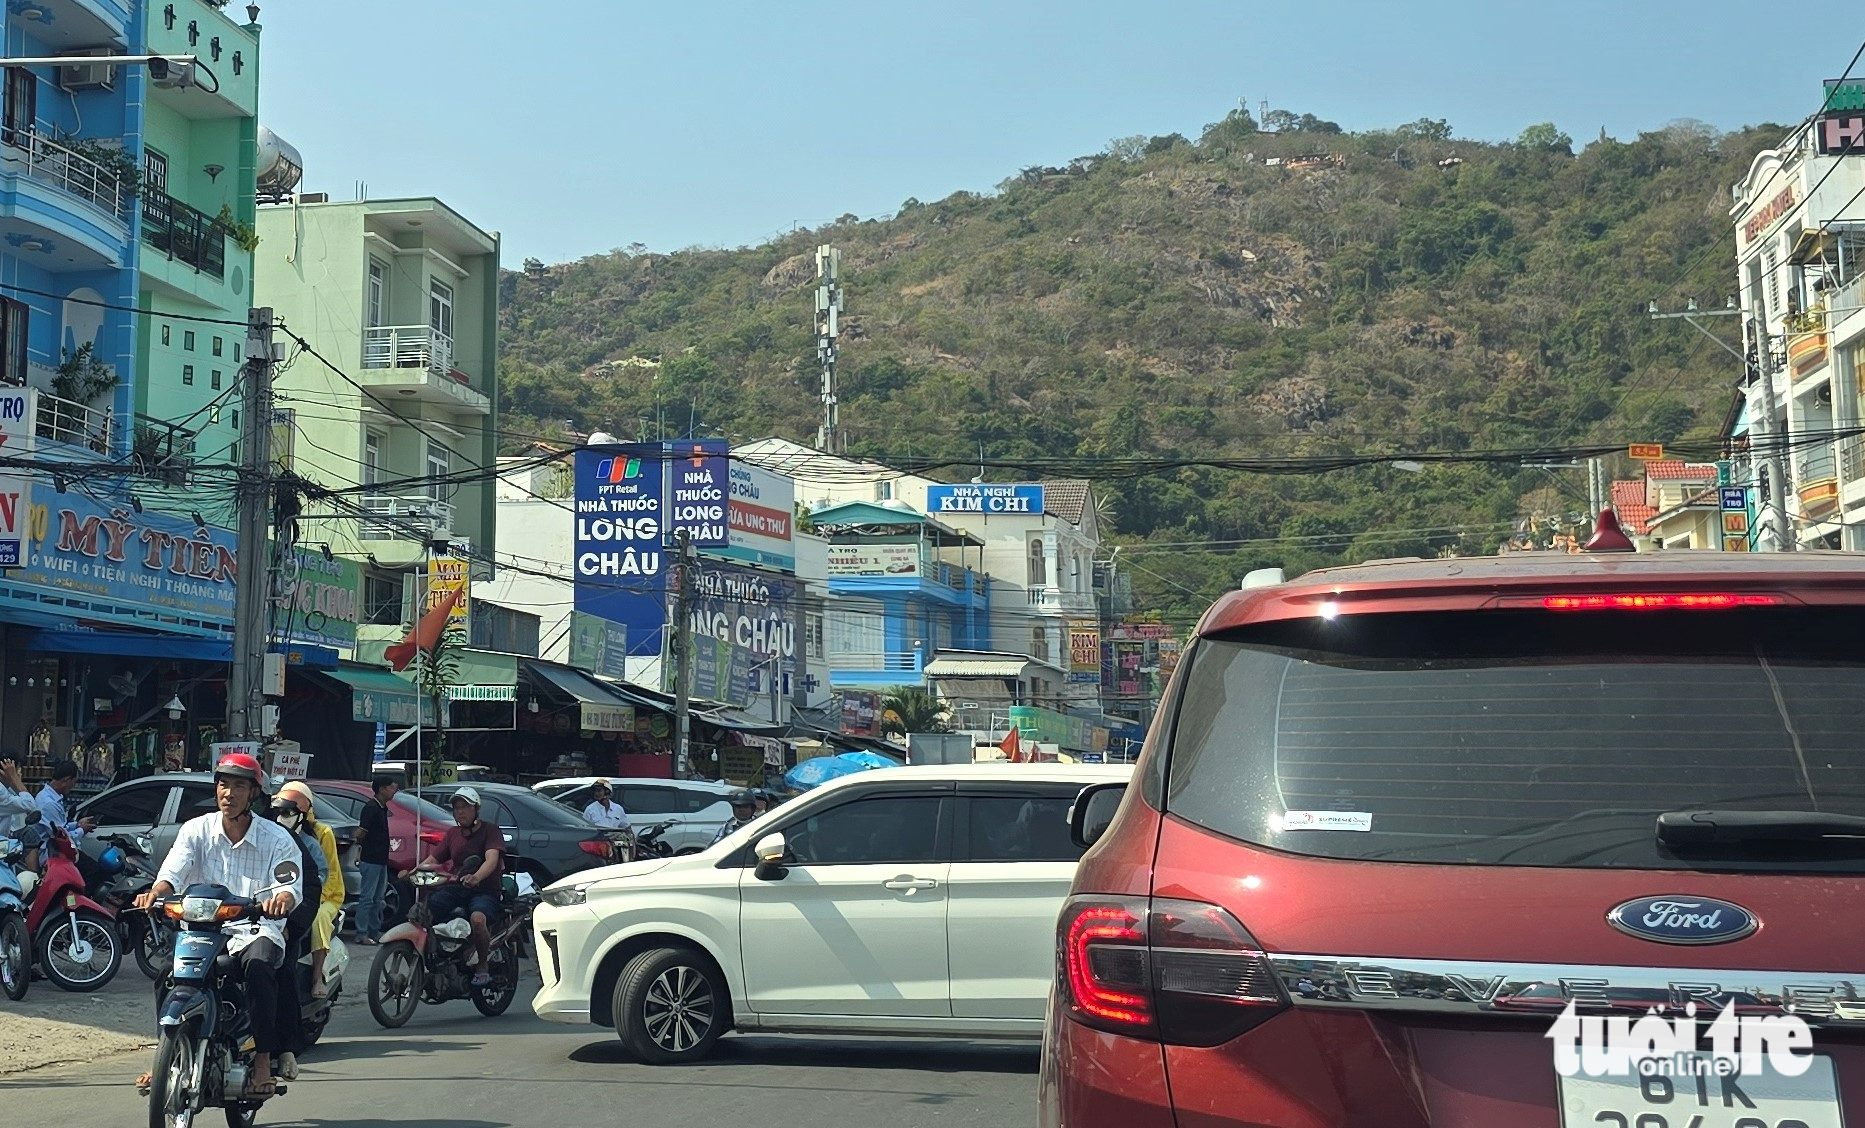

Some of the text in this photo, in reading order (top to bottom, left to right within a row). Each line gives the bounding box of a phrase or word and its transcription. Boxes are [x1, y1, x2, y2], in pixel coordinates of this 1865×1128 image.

[1826, 118, 1864, 148] H
[0, 397, 24, 422] RỌ
[684, 469, 714, 484] NHÀ
[598, 484, 638, 495] FPT Retail
[675, 484, 722, 502] THUỐC
[738, 483, 760, 500] CHÂU
[953, 485, 982, 497] NHÀ
[578, 493, 658, 513] NHÀ THUỐC
[674, 506, 724, 521] LONG
[940, 496, 1030, 512] KIM CHI
[578, 517, 659, 541] LONG
[674, 521, 724, 540] CHÂU
[728, 505, 786, 535] ỪA UNG THƯ
[55, 507, 136, 562] MỸ
[578, 546, 659, 576] CHÂU
[43, 555, 78, 574] WIFI
[91, 563, 126, 583] TIỆN
[130, 571, 161, 590] NGHI
[165, 578, 215, 600] THOÁNG
[430, 586, 467, 609] TÙG
[725, 576, 770, 607] THUỐC
[735, 611, 794, 657] CHÂU
[1072, 649, 1096, 664] CHI
[1642, 900, 1722, 929] Ford
